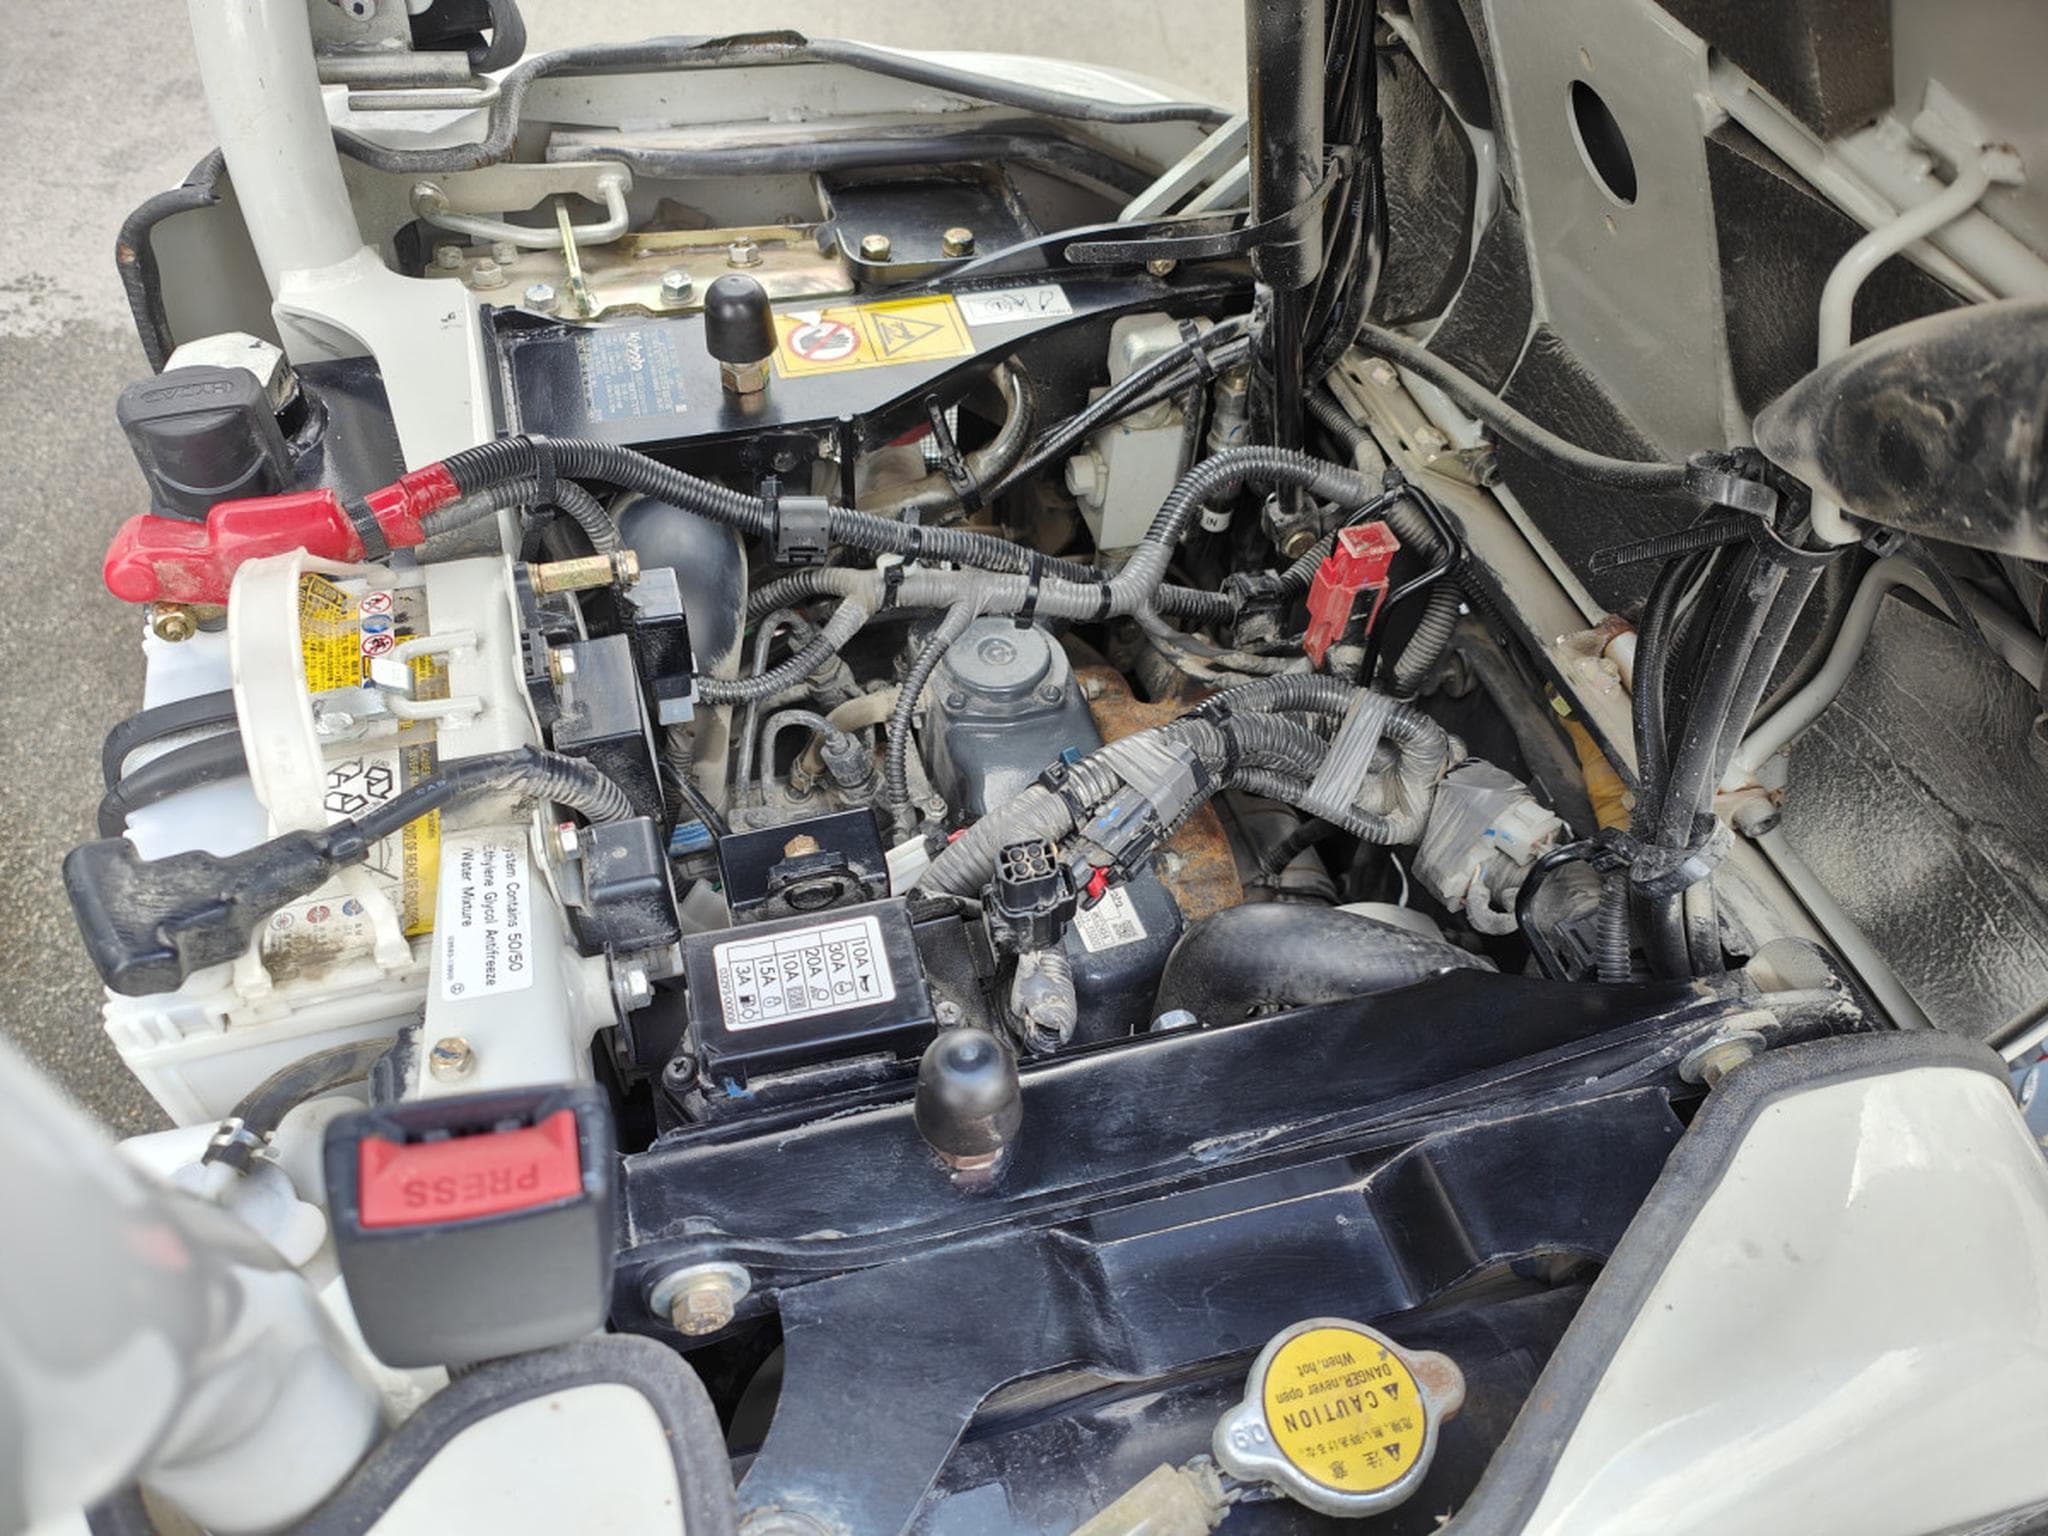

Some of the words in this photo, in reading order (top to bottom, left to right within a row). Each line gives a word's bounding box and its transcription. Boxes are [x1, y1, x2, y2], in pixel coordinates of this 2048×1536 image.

[462, 887, 474, 927] Mixture
[481, 892, 499, 924] Glycol
[506, 882, 520, 927] Contains
[485, 929, 500, 986] Antifreeze
[508, 933, 523, 971] 50/50
[804, 948, 822, 977] 20A
[828, 944, 845, 973] 30A
[851, 940, 869, 968] 10A
[736, 966, 753, 986] 3A
[758, 957, 775, 987] 15A
[781, 953, 798, 983] 10A
[402, 1163, 540, 1210] PRESS
[1275, 1384, 1302, 1406] open
[1282, 1390, 1379, 1433] CAUTION
